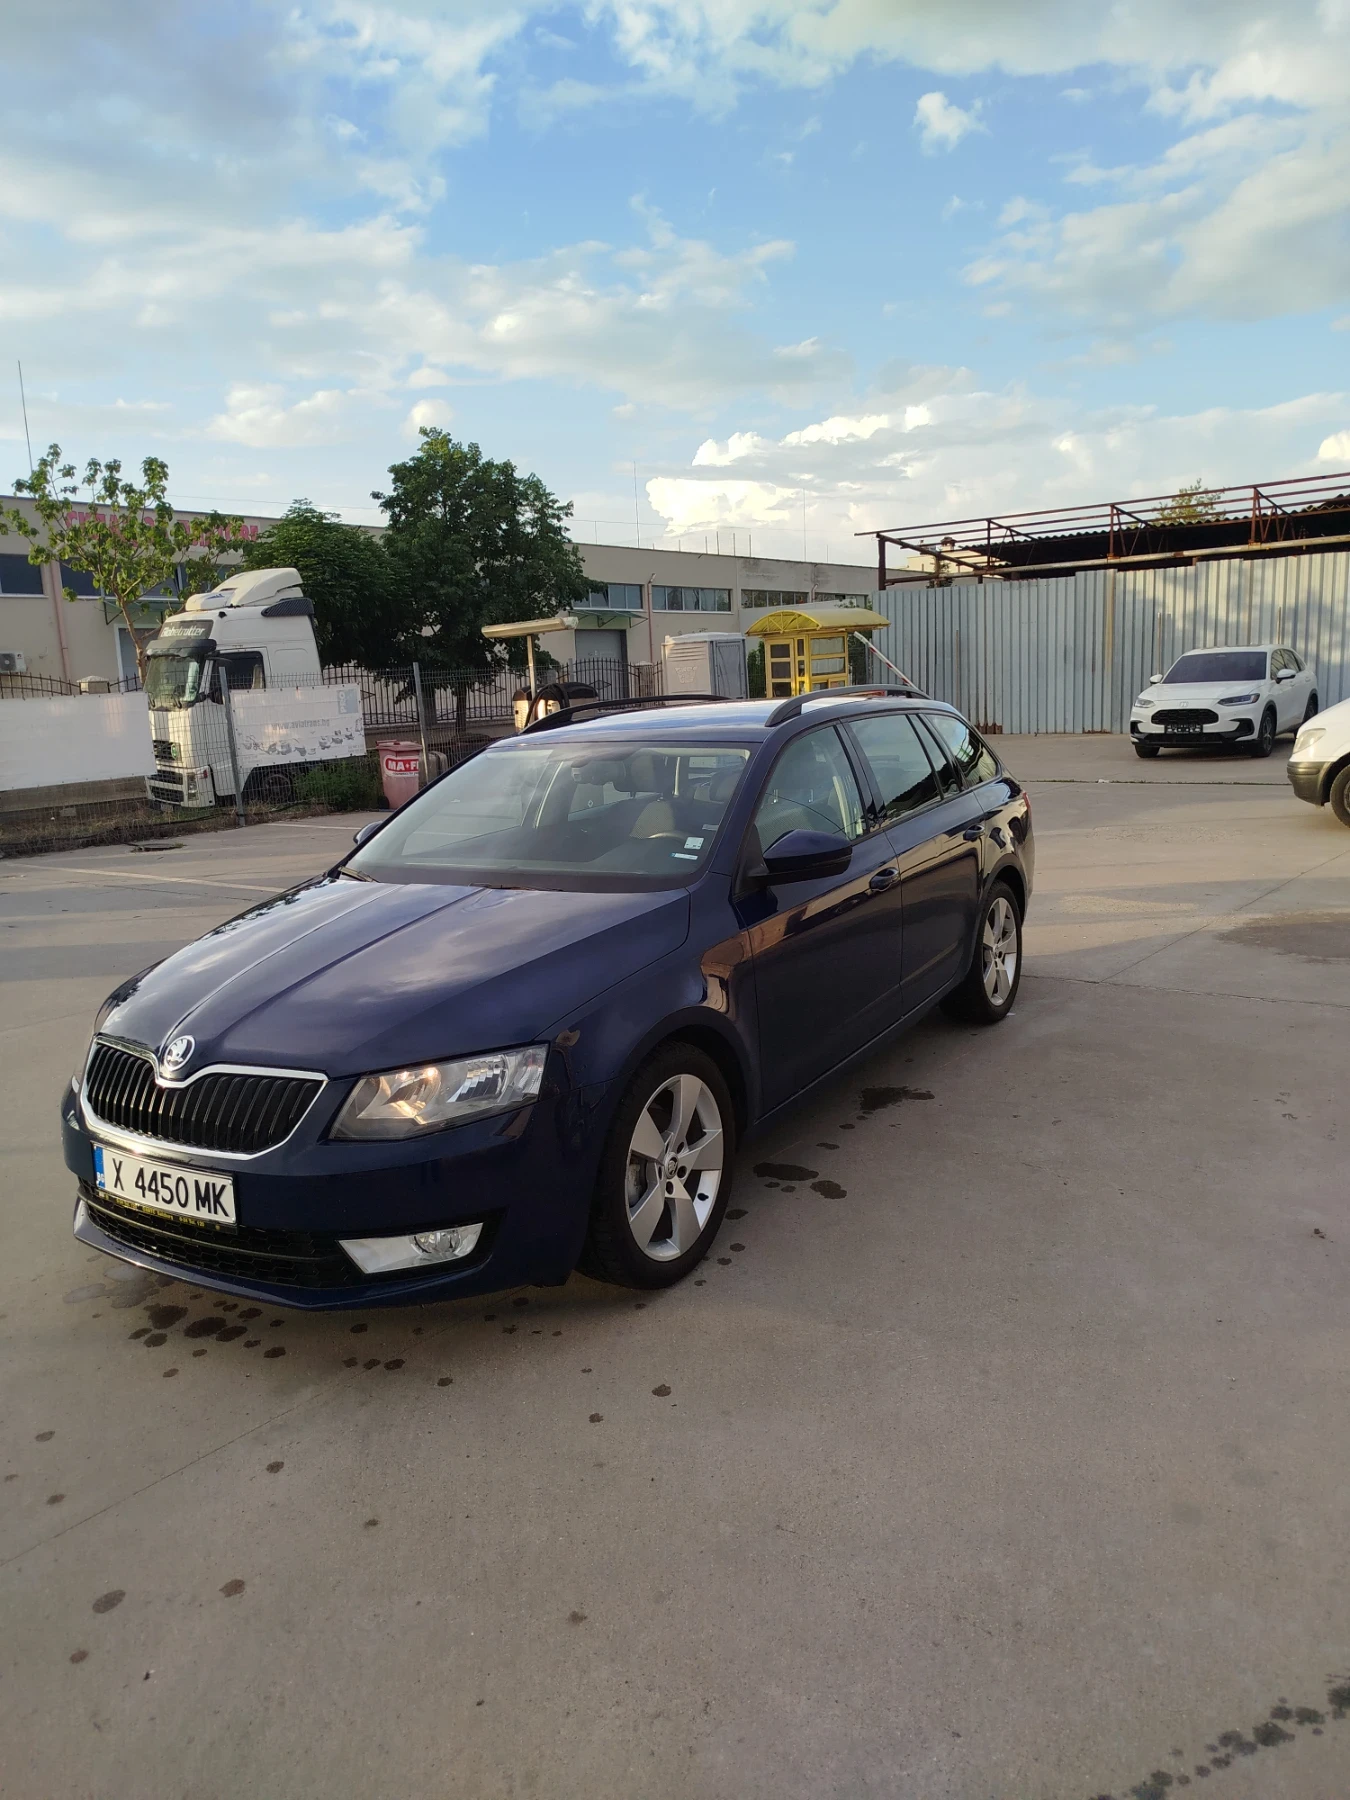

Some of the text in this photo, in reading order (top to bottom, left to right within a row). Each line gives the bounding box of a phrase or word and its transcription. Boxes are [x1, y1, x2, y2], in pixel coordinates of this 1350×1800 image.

[161, 625, 206, 637] Globetrotter
[112, 1157, 230, 1218] X 4450 MK
